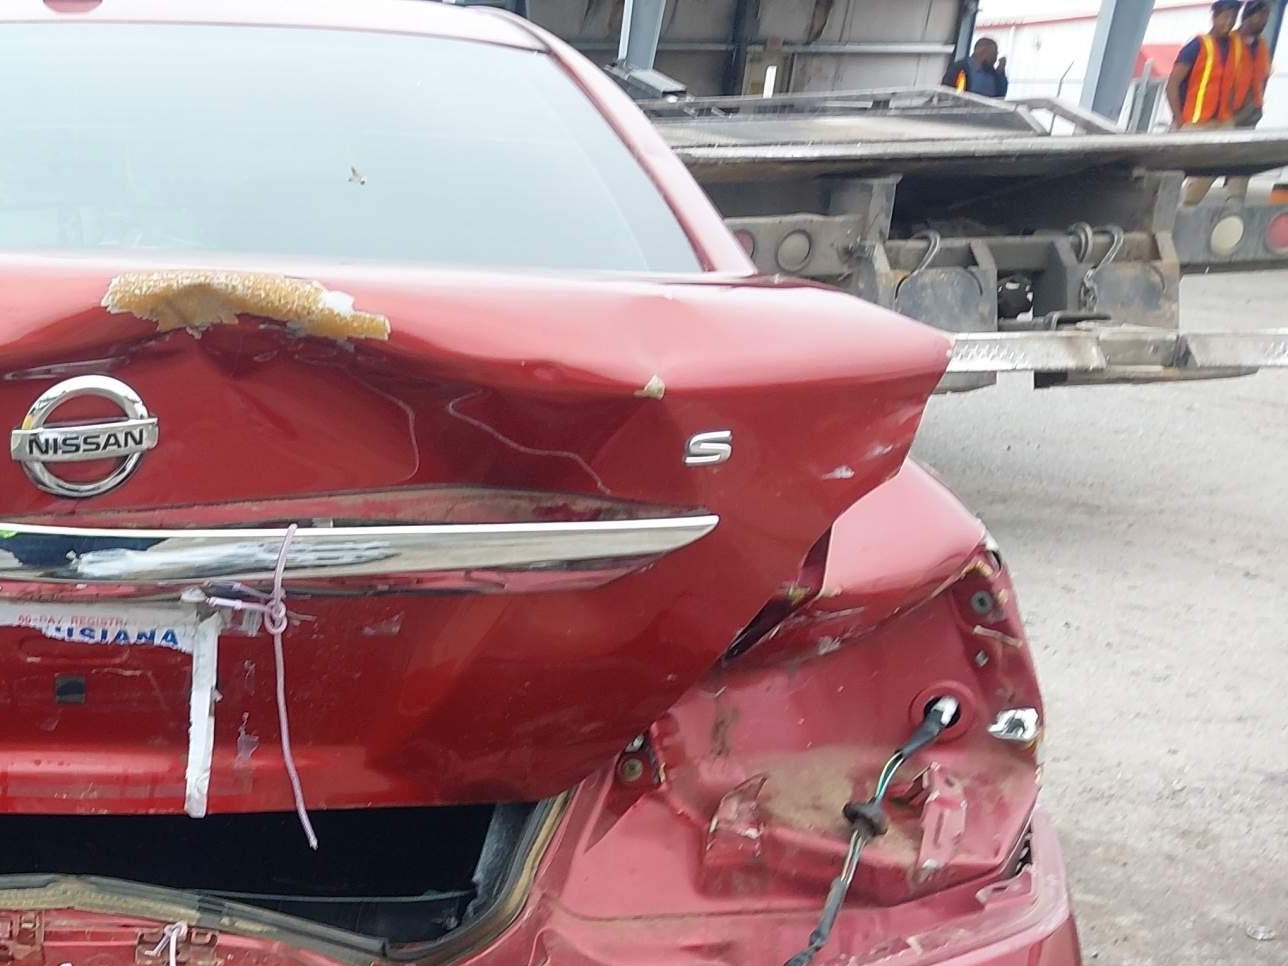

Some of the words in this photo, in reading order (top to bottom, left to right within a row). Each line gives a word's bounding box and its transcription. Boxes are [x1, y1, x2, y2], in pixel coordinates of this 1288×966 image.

[27, 428, 144, 456] NISSAN
[684, 429, 733, 464] S
[47, 626, 179, 646] ISIANA
